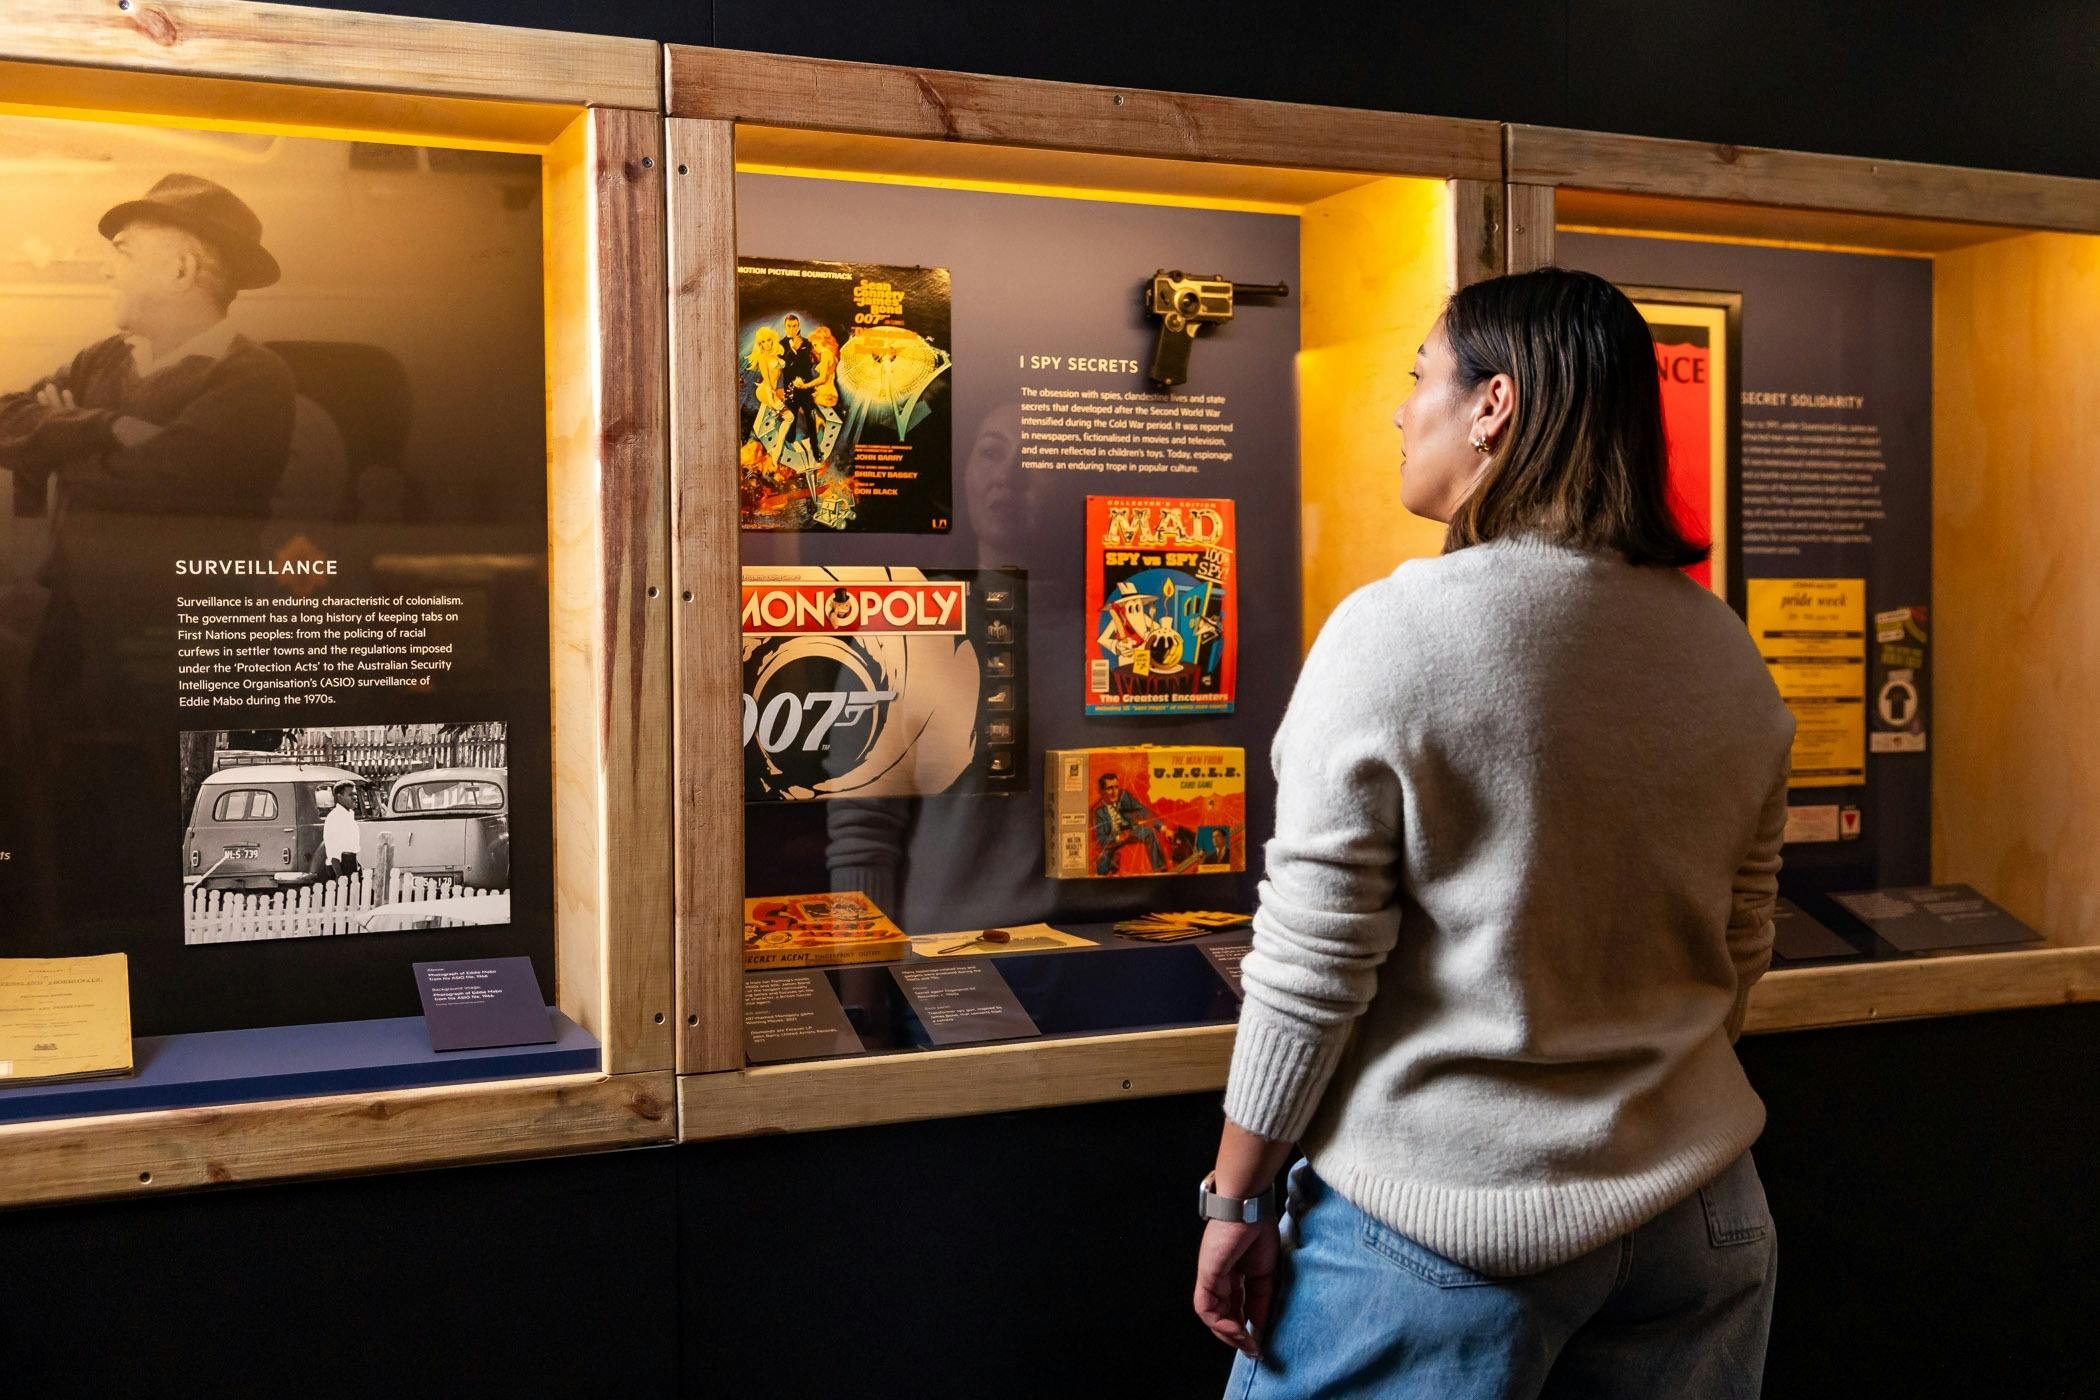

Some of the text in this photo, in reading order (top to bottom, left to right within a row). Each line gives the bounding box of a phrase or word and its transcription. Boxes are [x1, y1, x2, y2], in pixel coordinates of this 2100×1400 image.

[768, 268, 800, 276] PICTURE
[801, 271, 853, 280] SOUNDTRACK
[860, 279, 891, 290] Sean
[1019, 355, 1138, 373] I SPY SECRETS
[1020, 386, 1037, 397] The
[1038, 388, 1079, 398] obsession
[1080, 390, 1099, 399] with
[1170, 394, 1187, 402] lives
[1189, 394, 1204, 403] and
[1205, 395, 1225, 404] state
[1020, 402, 1220, 417] secrets that developed after the Second World War
[1021, 416, 1063, 426] intensified
[1064, 417, 1091, 429] during
[1093, 418, 1107, 427] the
[1108, 418, 1127, 428] Cold
[1128, 420, 1144, 429] War
[1174, 421, 1181, 430] It
[1182, 423, 1198, 431] was
[1199, 423, 1233, 433] reported
[1021, 430, 1029, 439] in
[1083, 431, 1130, 443] fictionalised
[1132, 434, 1140, 442] in
[1142, 435, 1169, 444] movies
[1171, 435, 1186, 444] and
[1021, 445, 1037, 454] and
[1038, 447, 1059, 455] even
[1060, 445, 1096, 456] reflected
[1097, 447, 1106, 456] in
[1192, 451, 1233, 461] espionage
[1021, 460, 1053, 469] remains
[1067, 460, 1104, 472] enduring
[1105, 462, 1127, 472] trope
[1129, 462, 1136, 471] in
[1138, 462, 1168, 472] popular
[1102, 507, 1224, 547] MAD
[175, 559, 337, 574] SURVEILLANCE
[1105, 552, 1140, 566] SPY
[1165, 553, 1198, 567] SPY
[177, 595, 463, 608] Surveillance is an enduring characteristic of colonialism.
[177, 611, 458, 625] The government has a long history of keeping tabs on
[178, 627, 425, 641] First Nations peoples: from the policing of racial
[178, 643, 452, 657] curfews in settler towns and the regulations imposed
[178, 663, 210, 673] under
[213, 662, 231, 672] the
[323, 662, 334, 671] to
[336, 660, 354, 670] the
[357, 659, 407, 670] Australian
[410, 659, 451, 671] Security
[179, 679, 240, 691] Intelligence
[319, 677, 355, 688] (ASIO)
[357, 676, 417, 686] surveillance
[419, 675, 430, 685] of
[179, 693, 336, 706] Eddie Mabo during the 1970s.
[1100, 693, 1229, 703] The Greatest Encounters
[780, 953, 809, 961] AGENT
